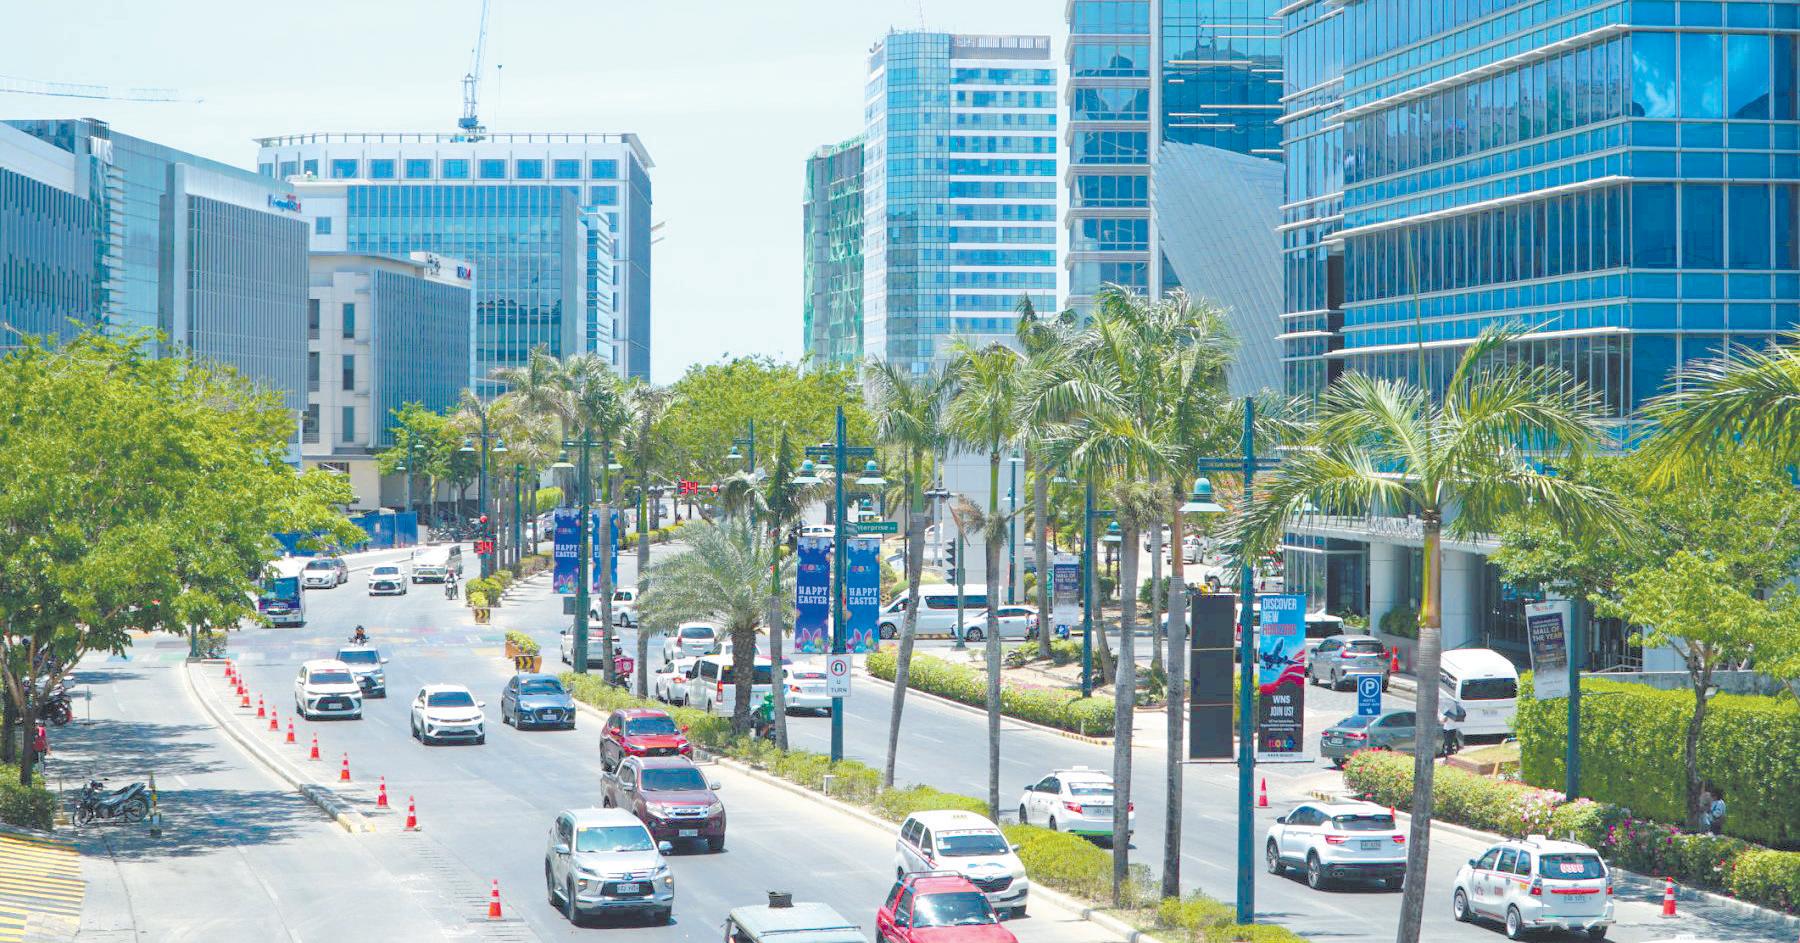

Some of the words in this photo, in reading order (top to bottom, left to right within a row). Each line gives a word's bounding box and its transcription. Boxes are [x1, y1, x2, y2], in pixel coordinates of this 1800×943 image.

[678, 478, 699, 496] 34
[476, 539, 495, 555] 34
[555, 543, 578, 551] HAPPY
[555, 550, 578, 558] EASTER
[798, 585, 828, 596] HAPPY
[848, 587, 878, 597] HAPPY
[798, 595, 828, 605] EASTER
[848, 596, 878, 606] EASTER
[1262, 598, 1297, 611] DISCOVER
[1262, 610, 1279, 623] NEW
[1532, 627, 1550, 635] MALL
[1551, 625, 1560, 633] OF
[1532, 634, 1545, 642] THE
[1545, 631, 1563, 640] YEAR
[1366, 681, 1375, 694] P
[1272, 695, 1291, 704] WNS
[1270, 706, 1283, 717] JOIN
[1284, 706, 1294, 717] US!
